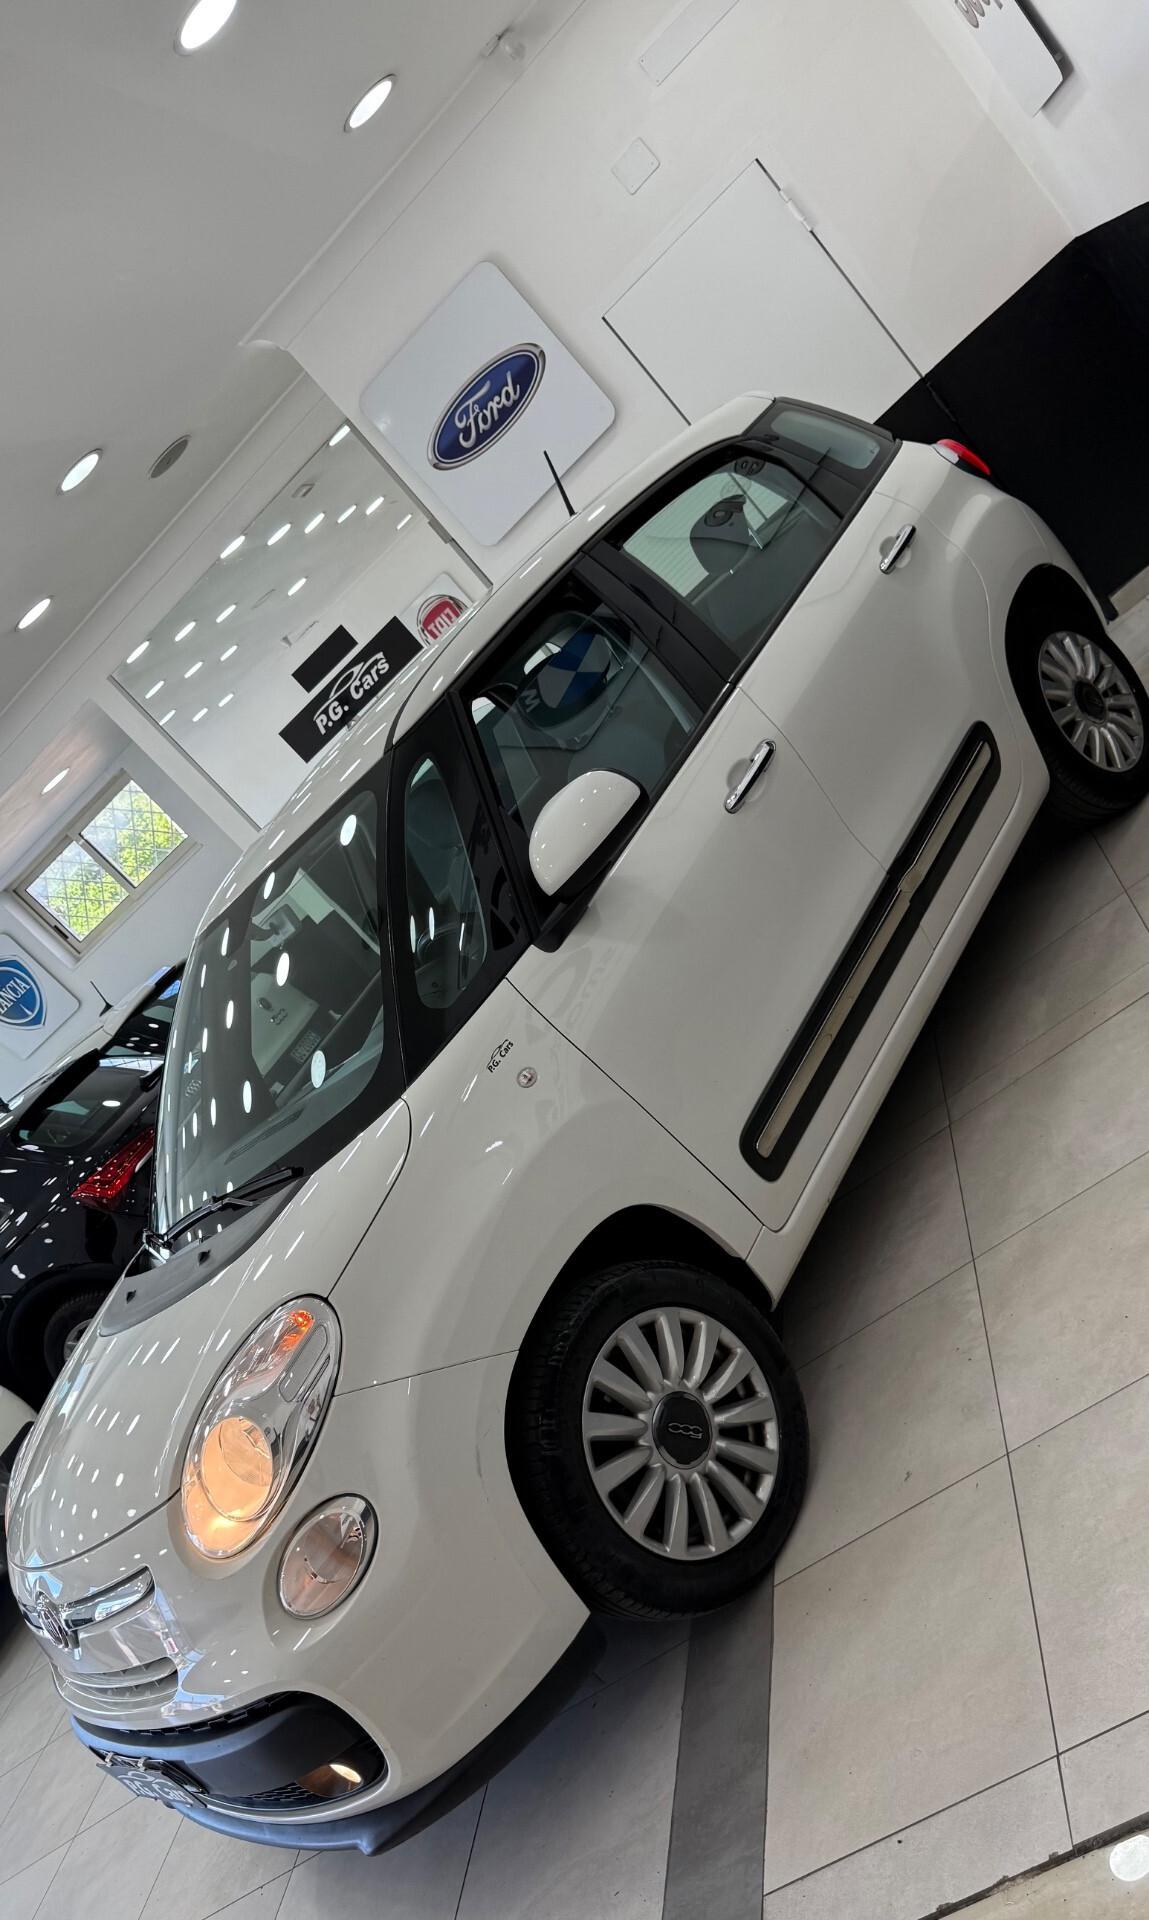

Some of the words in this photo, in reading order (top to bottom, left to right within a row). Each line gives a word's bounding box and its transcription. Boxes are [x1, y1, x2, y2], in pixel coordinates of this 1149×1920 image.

[454, 370, 521, 448] Ford
[315, 700, 349, 735] P.G.
[349, 658, 390, 700] Cars
[487, 1060, 501, 1073] P.G.
[500, 1041, 514, 1057] Cars
